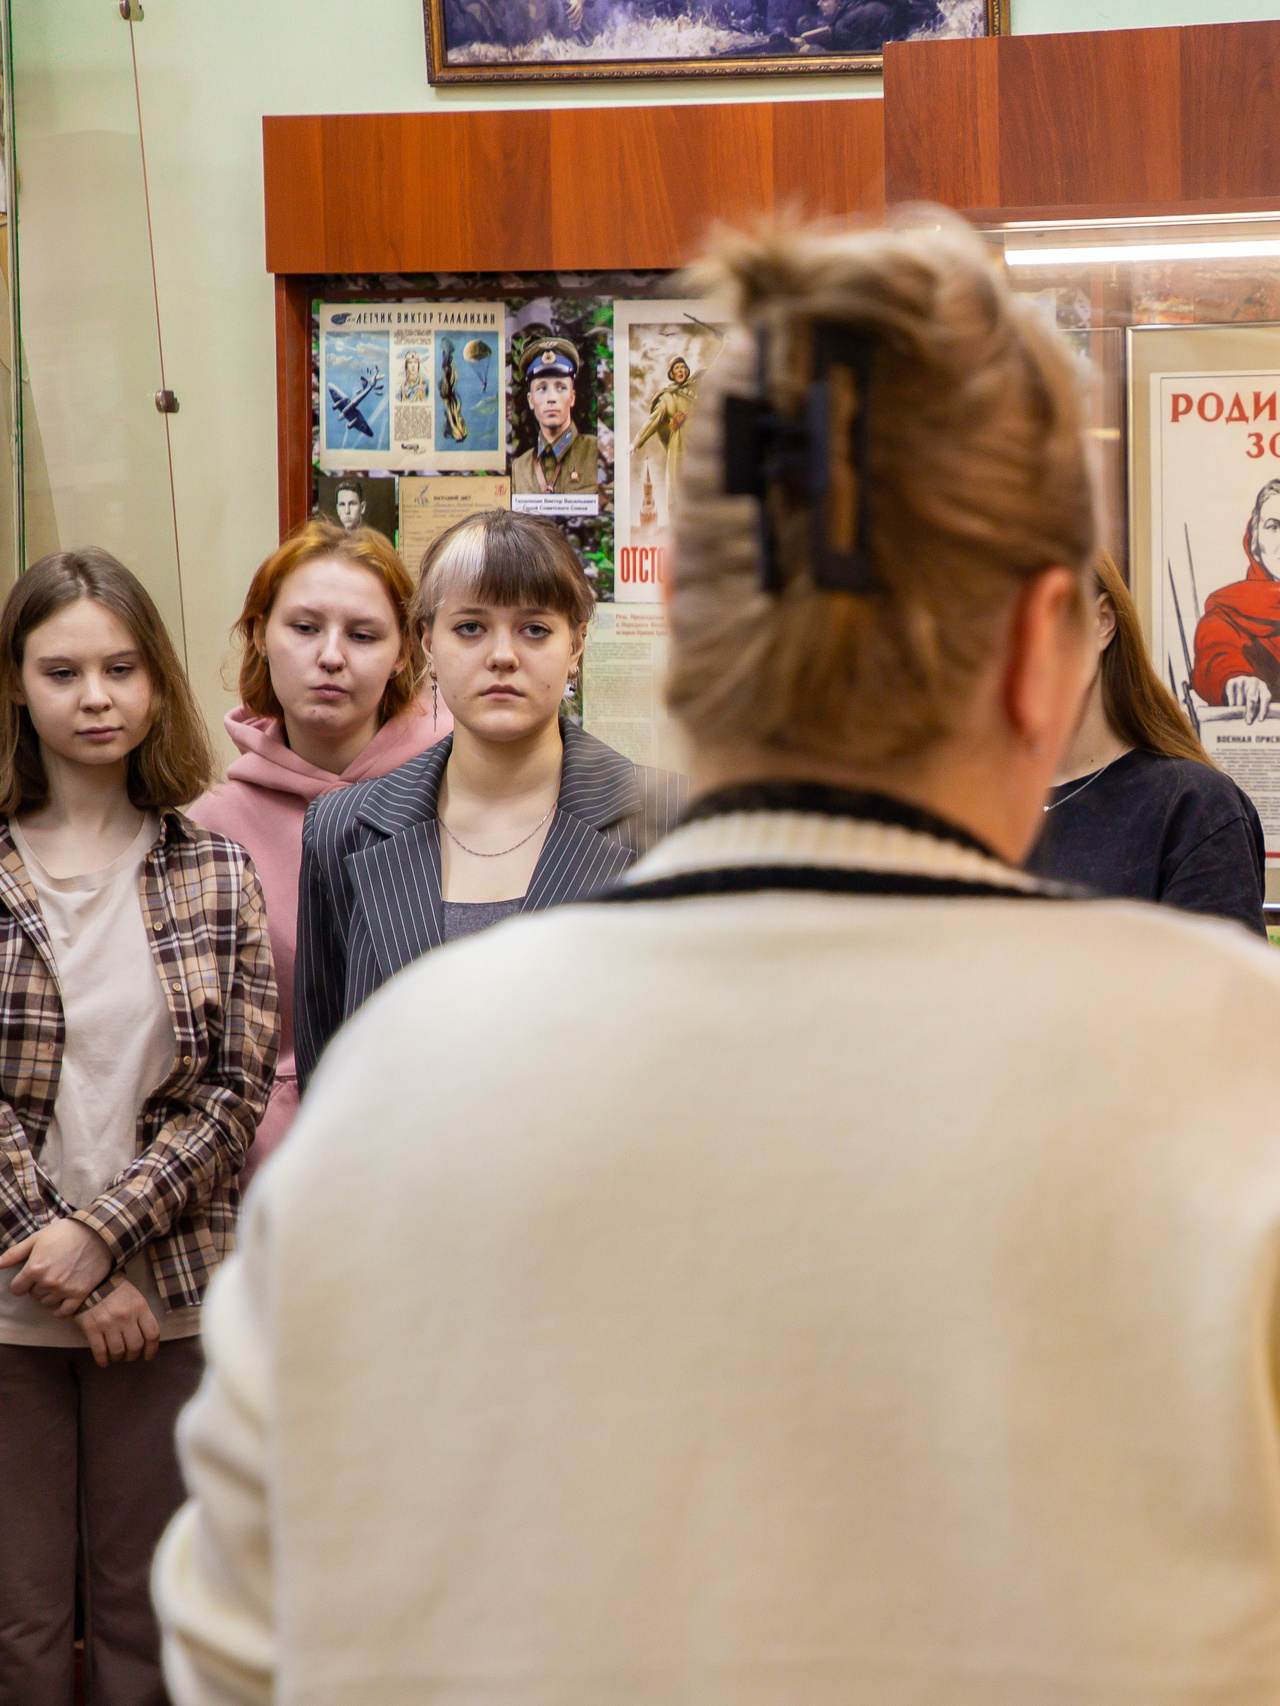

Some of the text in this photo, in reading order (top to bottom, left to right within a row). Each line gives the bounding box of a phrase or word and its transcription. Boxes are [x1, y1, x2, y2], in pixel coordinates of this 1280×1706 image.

[356, 312, 496, 324] ЛЕТЧИК ВИКТОР ТАЛАЛИХИН
[1216, 735, 1252, 743] ВОЕННАЯ
